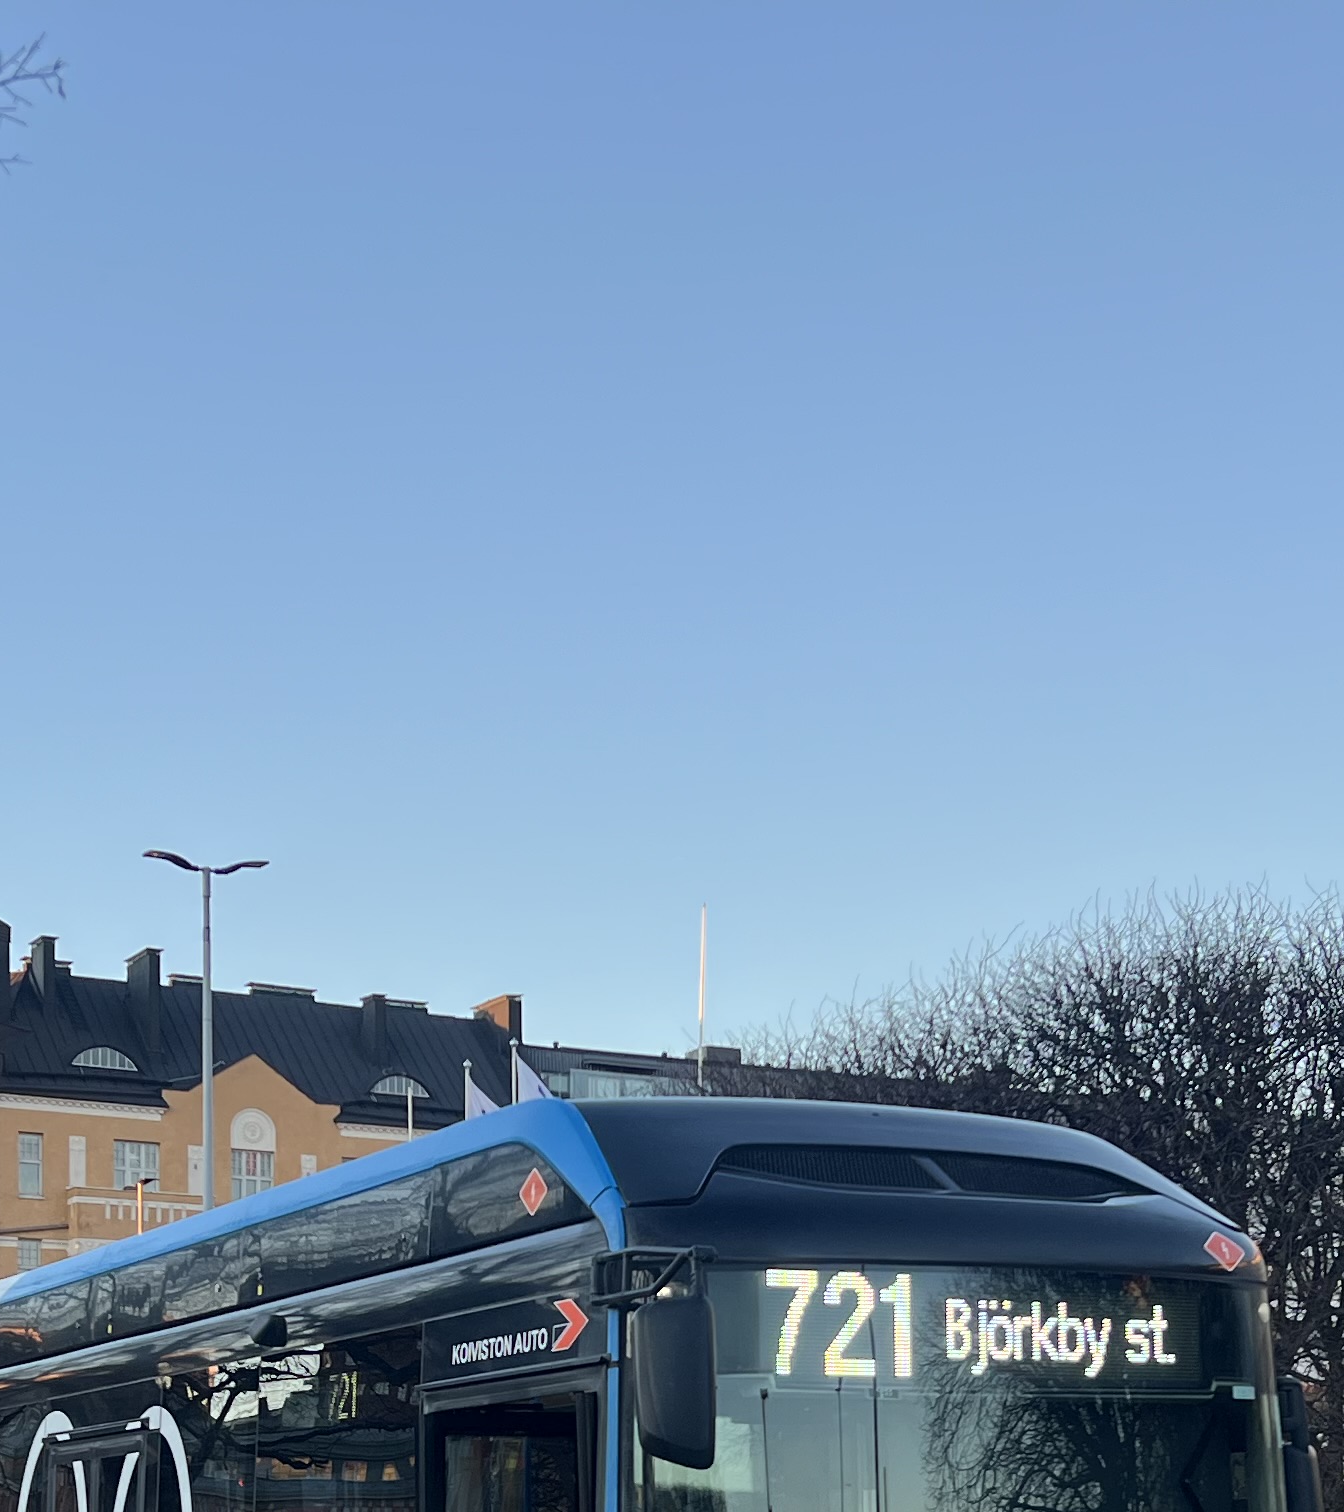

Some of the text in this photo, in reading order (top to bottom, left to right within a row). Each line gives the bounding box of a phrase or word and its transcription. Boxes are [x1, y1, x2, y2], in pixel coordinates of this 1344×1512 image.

[451, 1327, 549, 1366] KOIVISTON AUTO
[765, 1268, 913, 1378] 721
[945, 1297, 1113, 1379] Björkby
